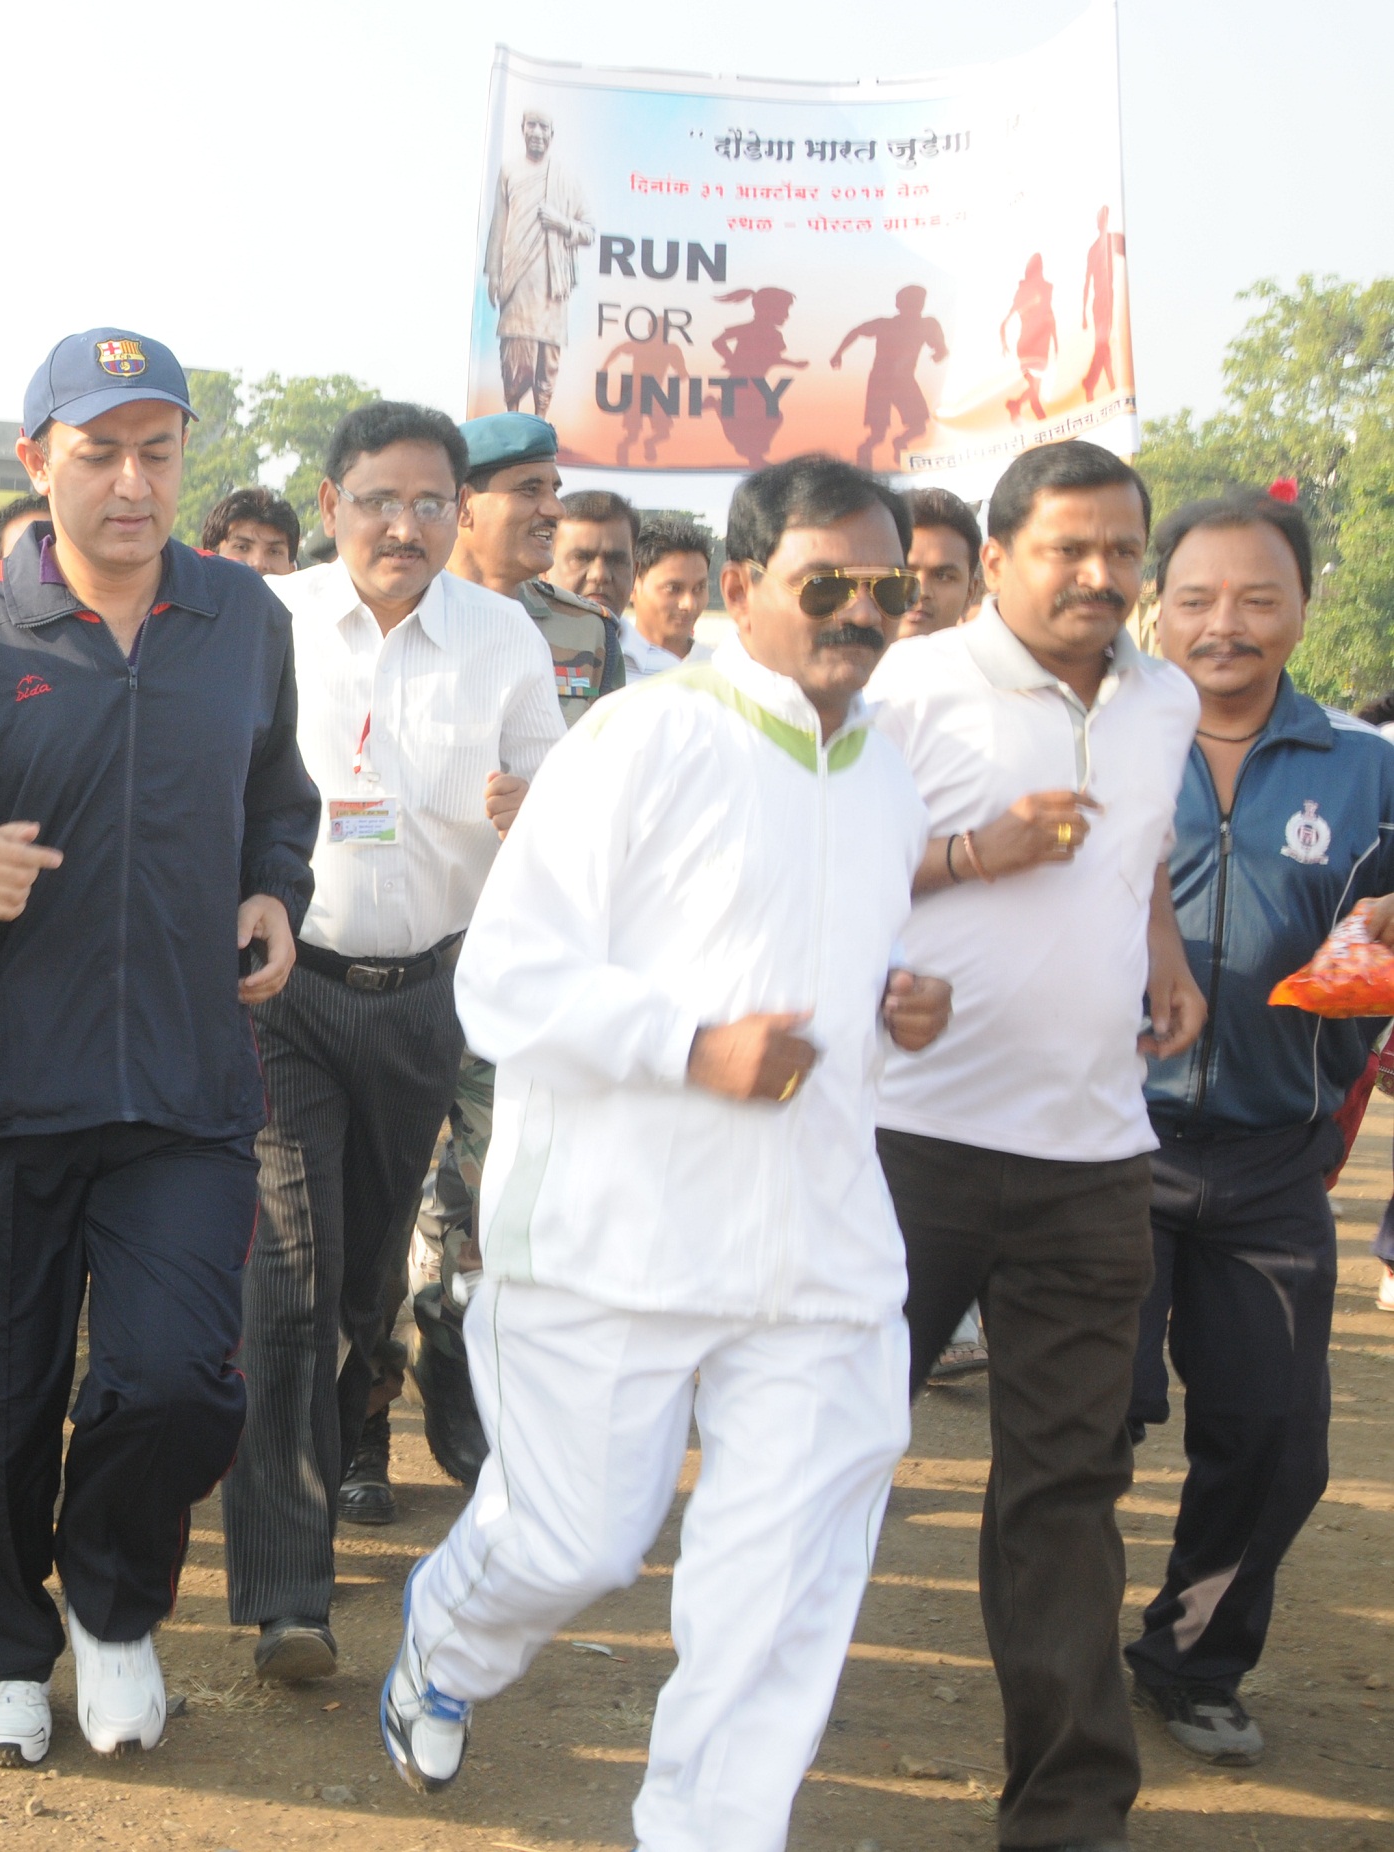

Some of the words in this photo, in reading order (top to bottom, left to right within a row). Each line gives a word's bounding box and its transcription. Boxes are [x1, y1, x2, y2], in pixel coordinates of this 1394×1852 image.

[804, 137, 878, 164] भारत
[629, 171, 690, 194] दिनांक
[599, 235, 727, 282] RUN
[598, 303, 693, 345] FOR
[595, 371, 794, 418] UNITY
